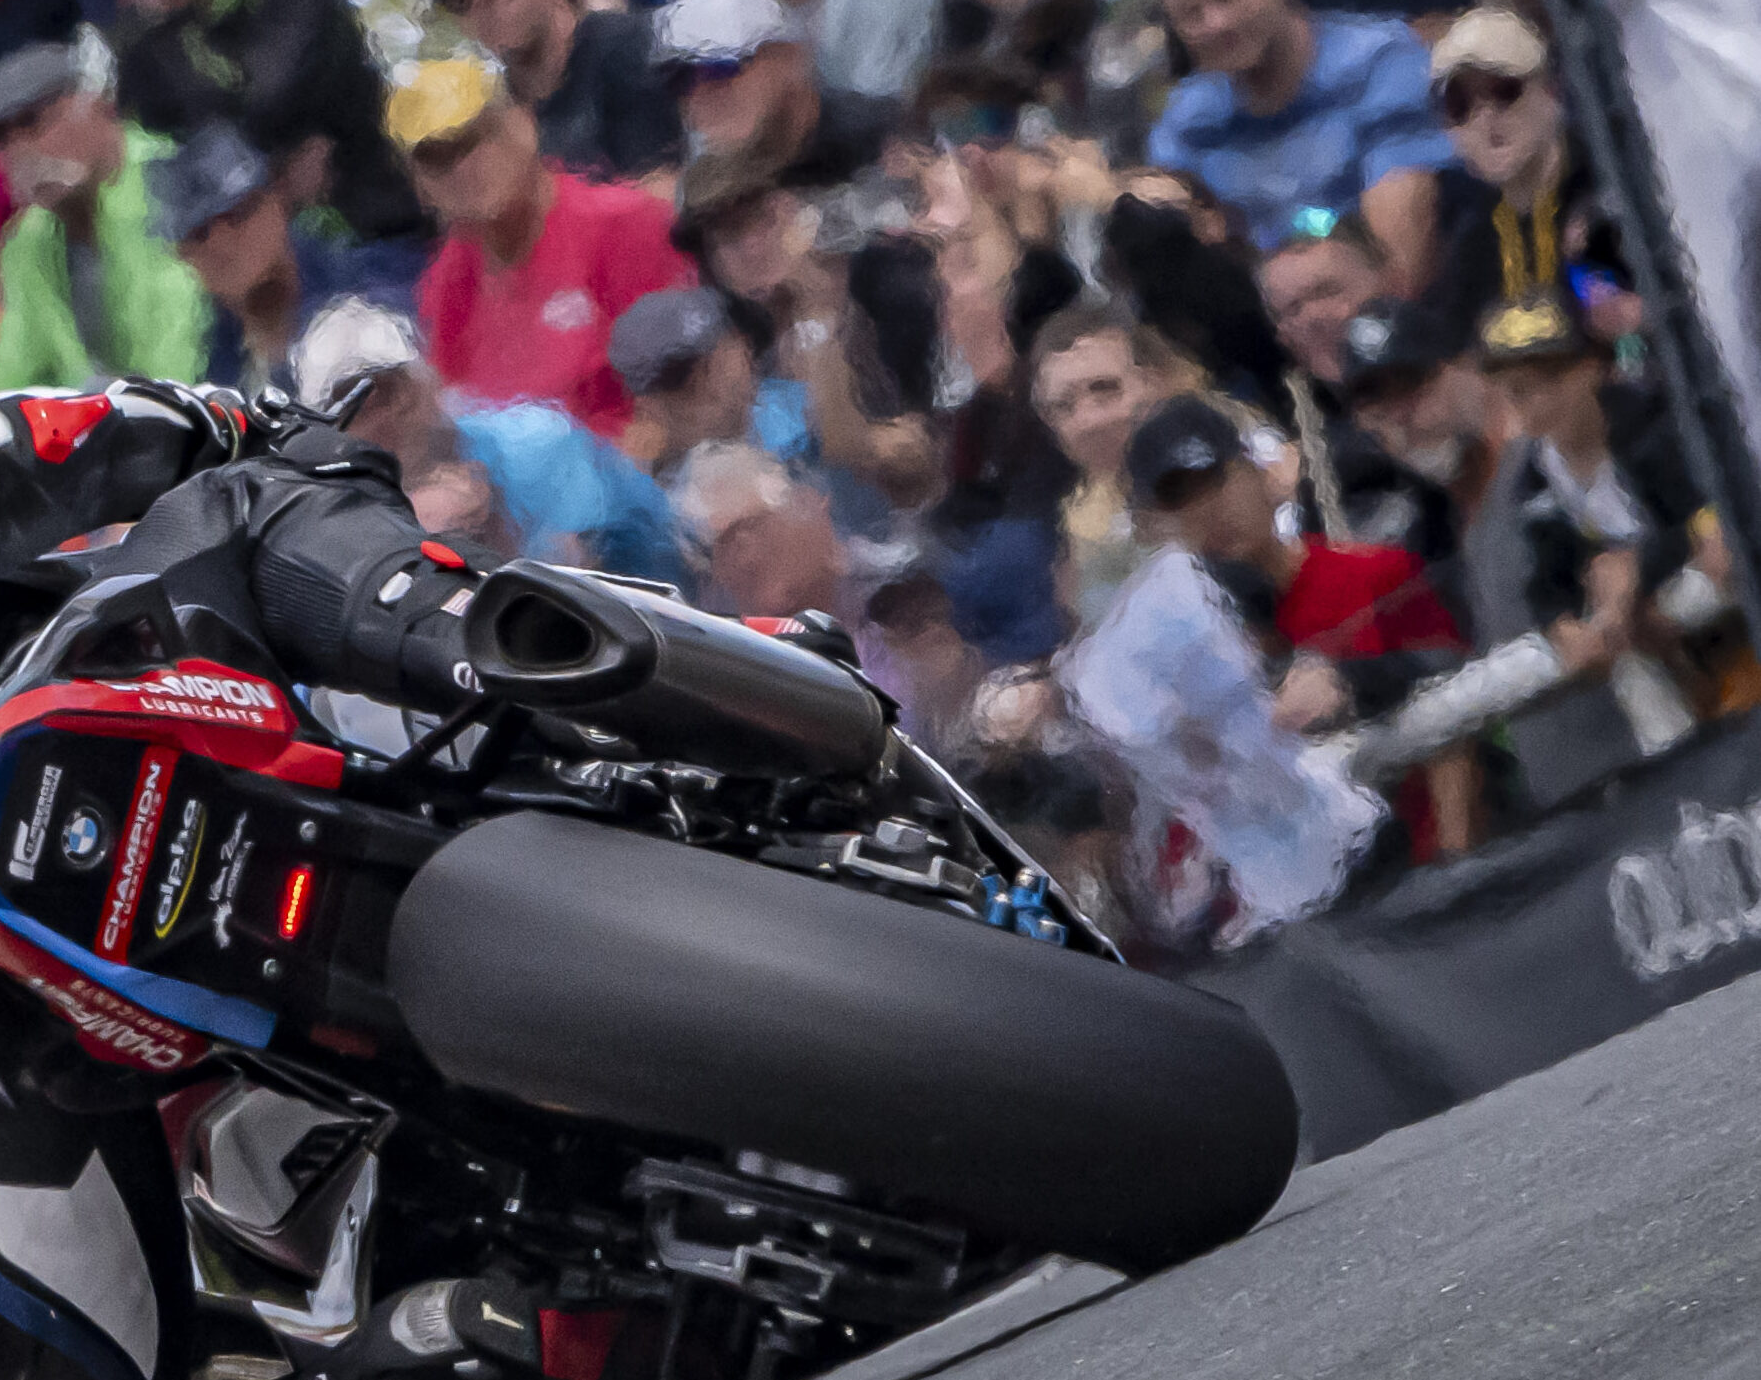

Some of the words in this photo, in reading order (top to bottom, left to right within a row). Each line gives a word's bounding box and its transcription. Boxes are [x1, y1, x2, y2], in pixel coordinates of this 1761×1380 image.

[140, 697, 264, 724] LUBRICANTS
[103, 762, 162, 951] CHAMPION
[157, 799, 198, 924] alpha
